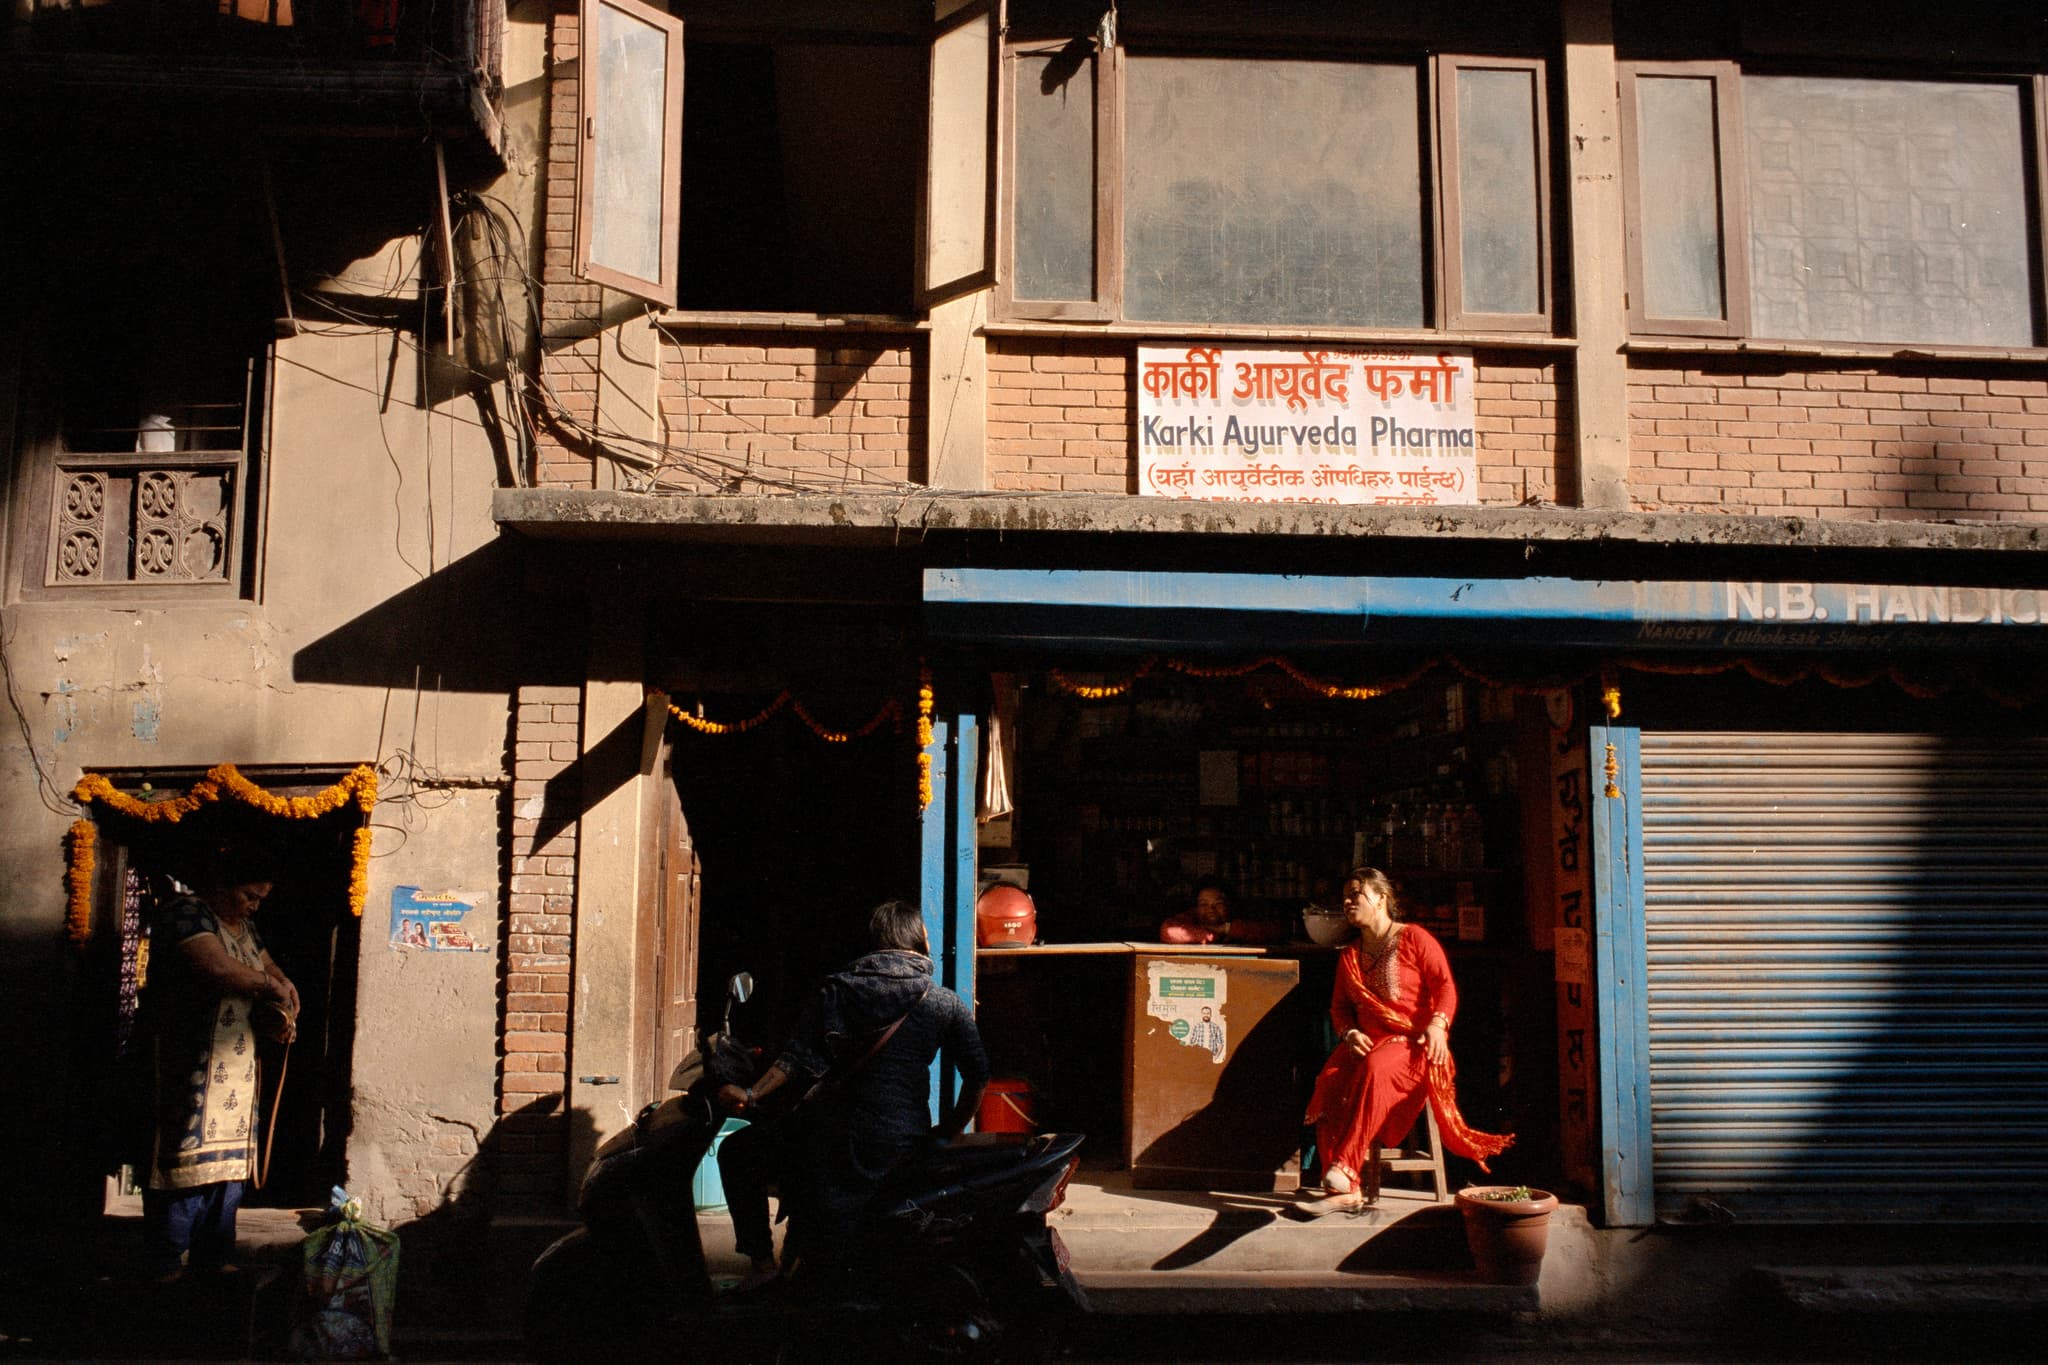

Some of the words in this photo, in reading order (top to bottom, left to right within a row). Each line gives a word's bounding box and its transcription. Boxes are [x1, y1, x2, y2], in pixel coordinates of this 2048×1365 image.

[1143, 347, 1222, 399] कार्की
[1233, 350, 1351, 409] आयूर्वेद
[1364, 351, 1459, 403] फर्मा
[1143, 415, 1213, 447] Karki
[1223, 415, 1357, 454] Ayurveda
[1371, 416, 1473, 449] Pharma
[1726, 581, 1828, 620] N.B.
[1846, 584, 2048, 624] HANDIC
